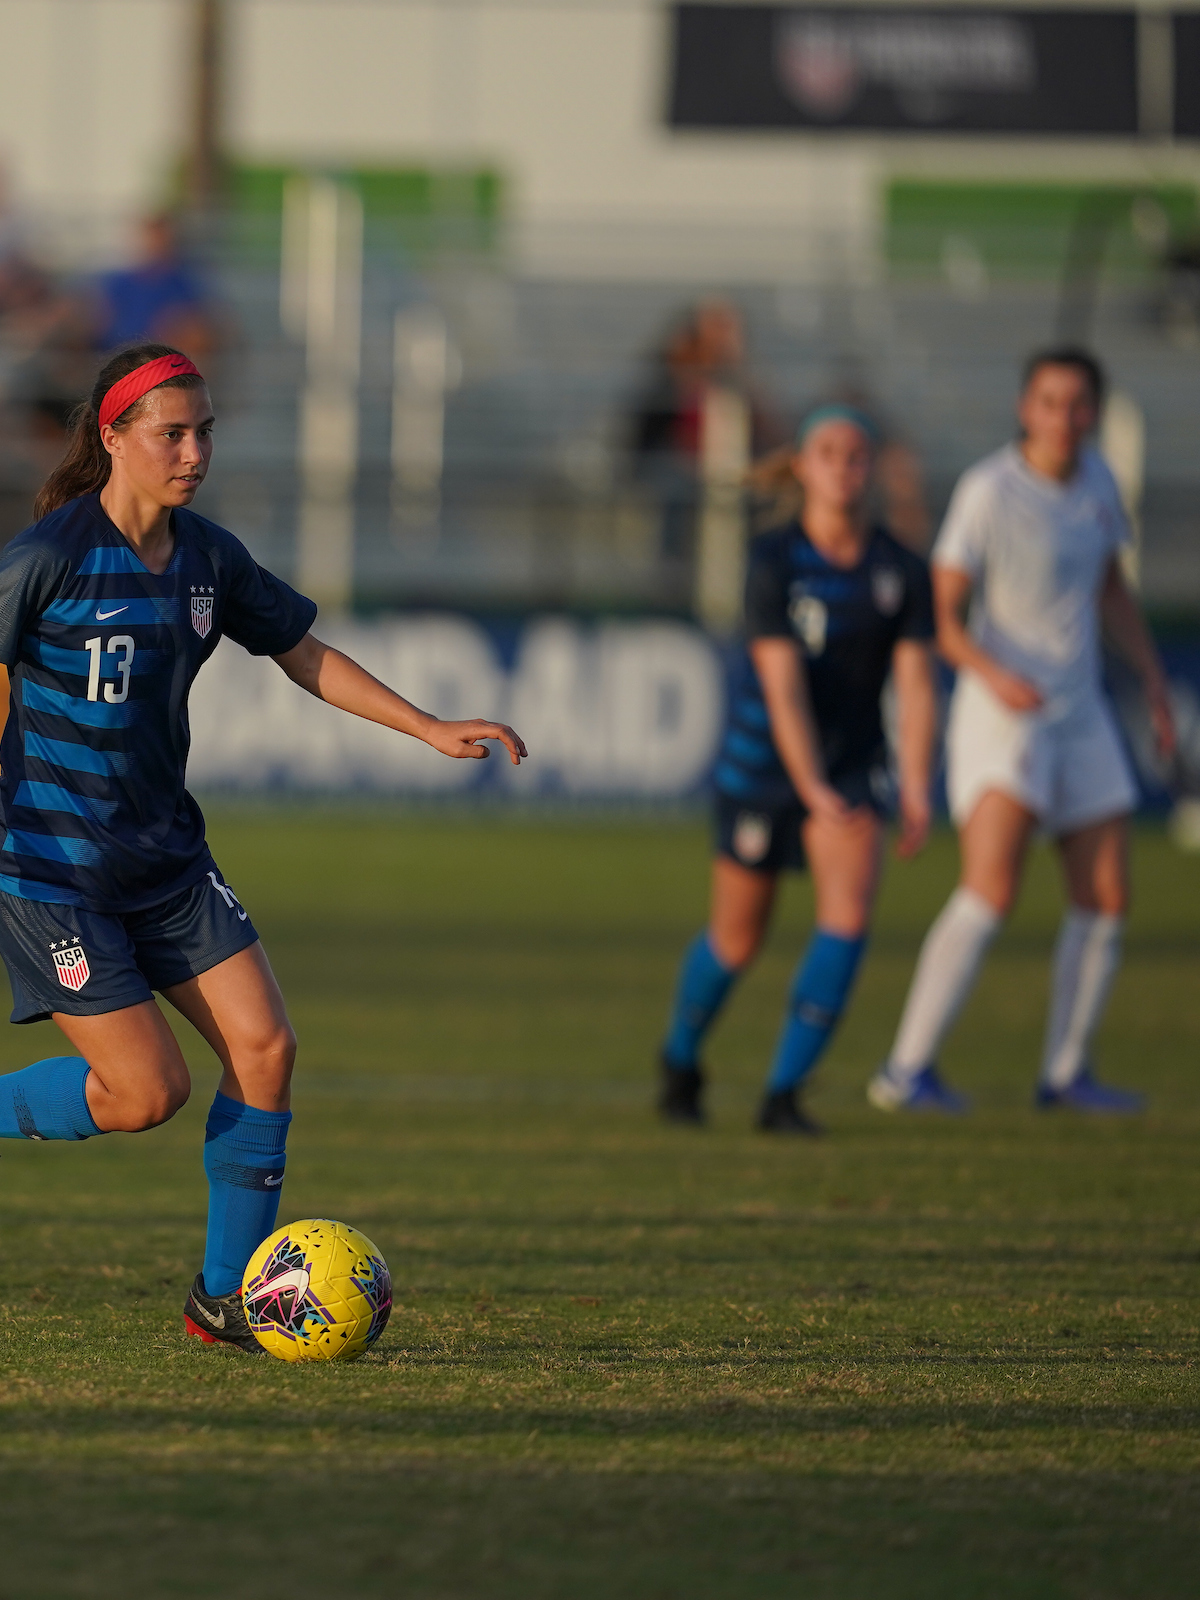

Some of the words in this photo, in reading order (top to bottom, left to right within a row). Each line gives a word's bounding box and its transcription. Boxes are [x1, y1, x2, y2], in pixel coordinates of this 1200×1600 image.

[192, 599, 212, 615] USA
[84, 634, 136, 704] 13
[54, 948, 83, 967] USA
